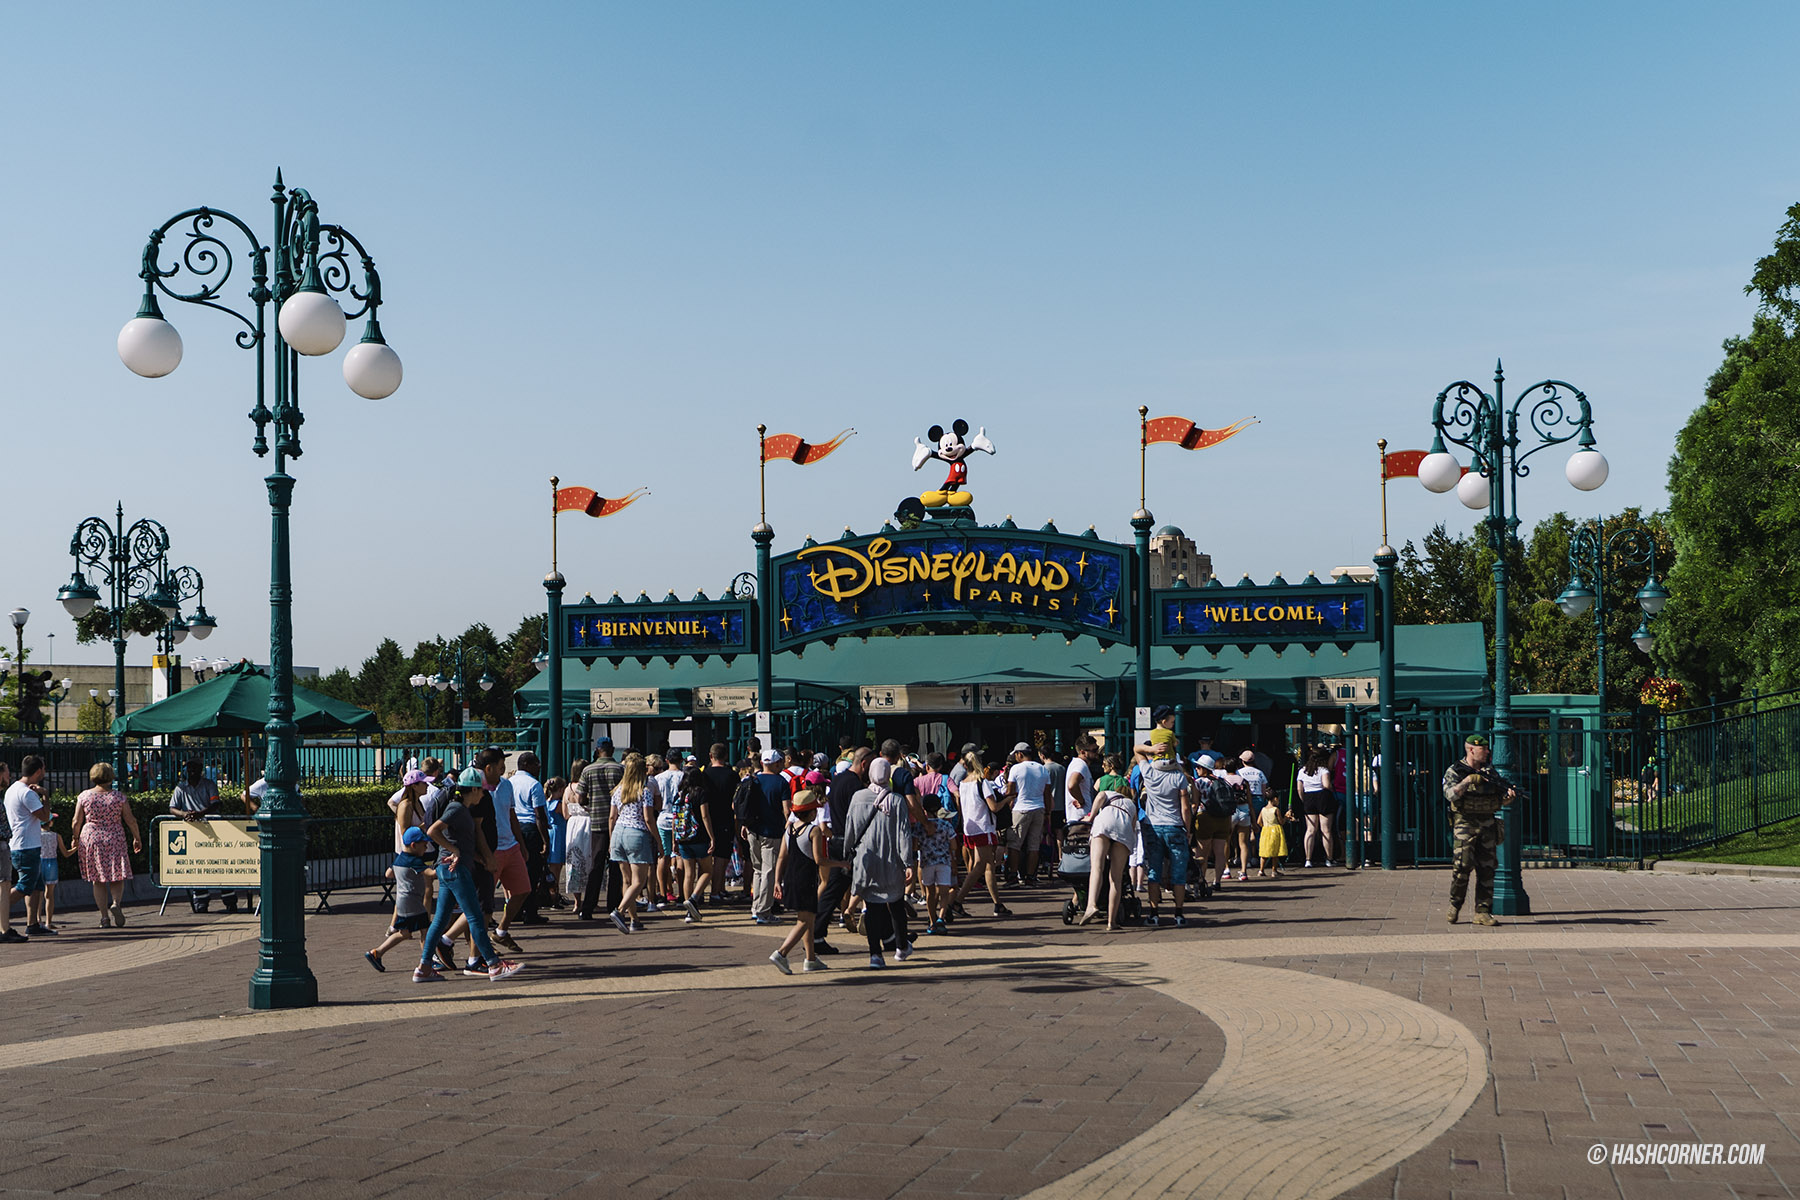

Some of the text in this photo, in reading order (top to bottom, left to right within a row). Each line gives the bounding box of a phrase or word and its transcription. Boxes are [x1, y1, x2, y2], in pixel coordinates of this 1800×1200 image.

[797, 537, 1069, 602] DISNEYLAND
[969, 588, 1060, 611] PARIS
[1210, 605, 1318, 623] WELCOME
[601, 620, 702, 637] BIENVENUE
[186, 867, 197, 875] MUST
[197, 867, 202, 875] BE
[225, 867, 233, 875] FOR
